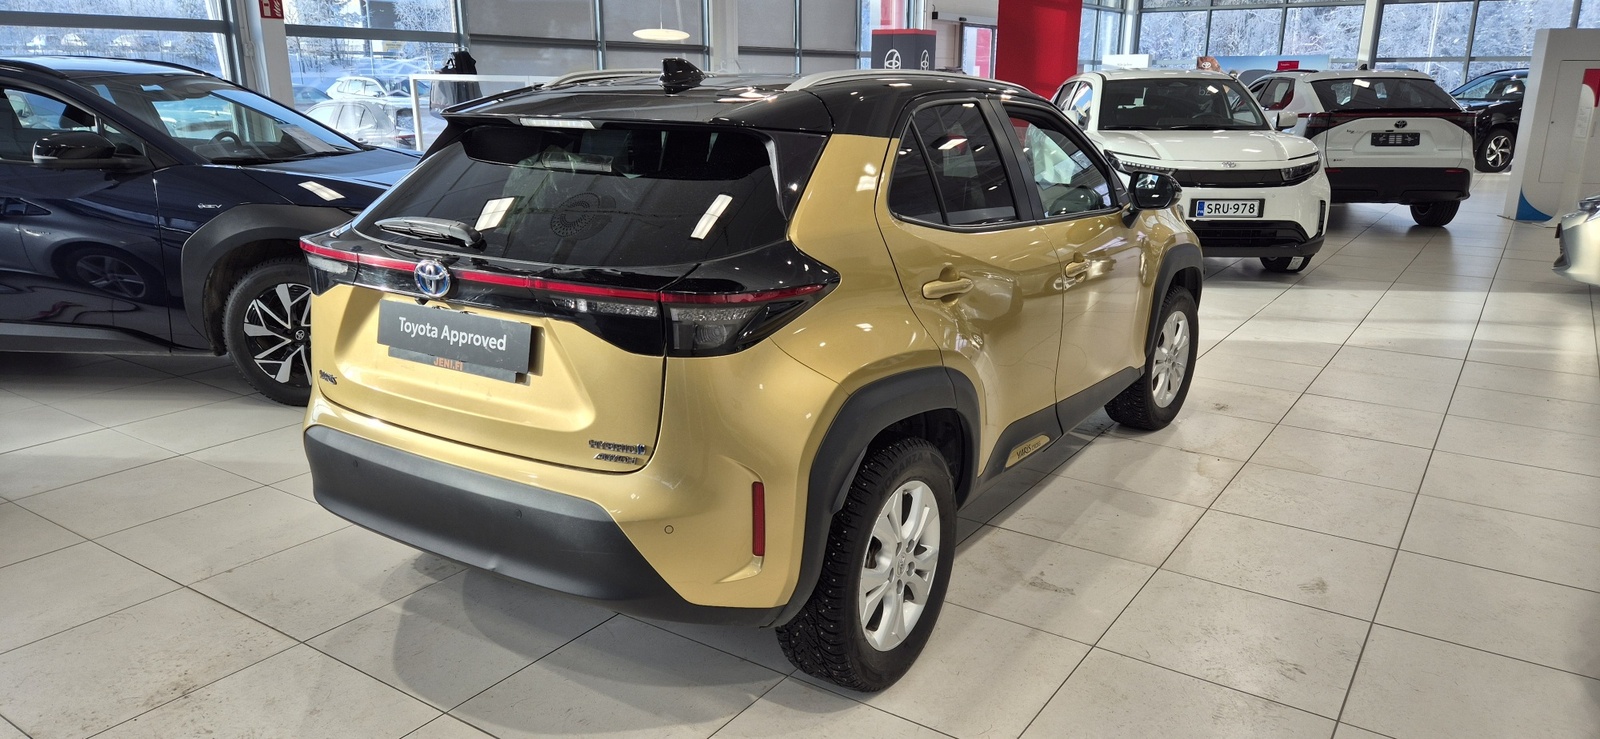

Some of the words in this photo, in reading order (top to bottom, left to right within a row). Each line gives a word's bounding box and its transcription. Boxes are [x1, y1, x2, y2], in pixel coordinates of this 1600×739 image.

[1207, 203, 1255, 214] SRU-978
[398, 317, 438, 338] Toyota
[440, 324, 507, 351] Approved
[433, 357, 464, 371] JENI.FI
